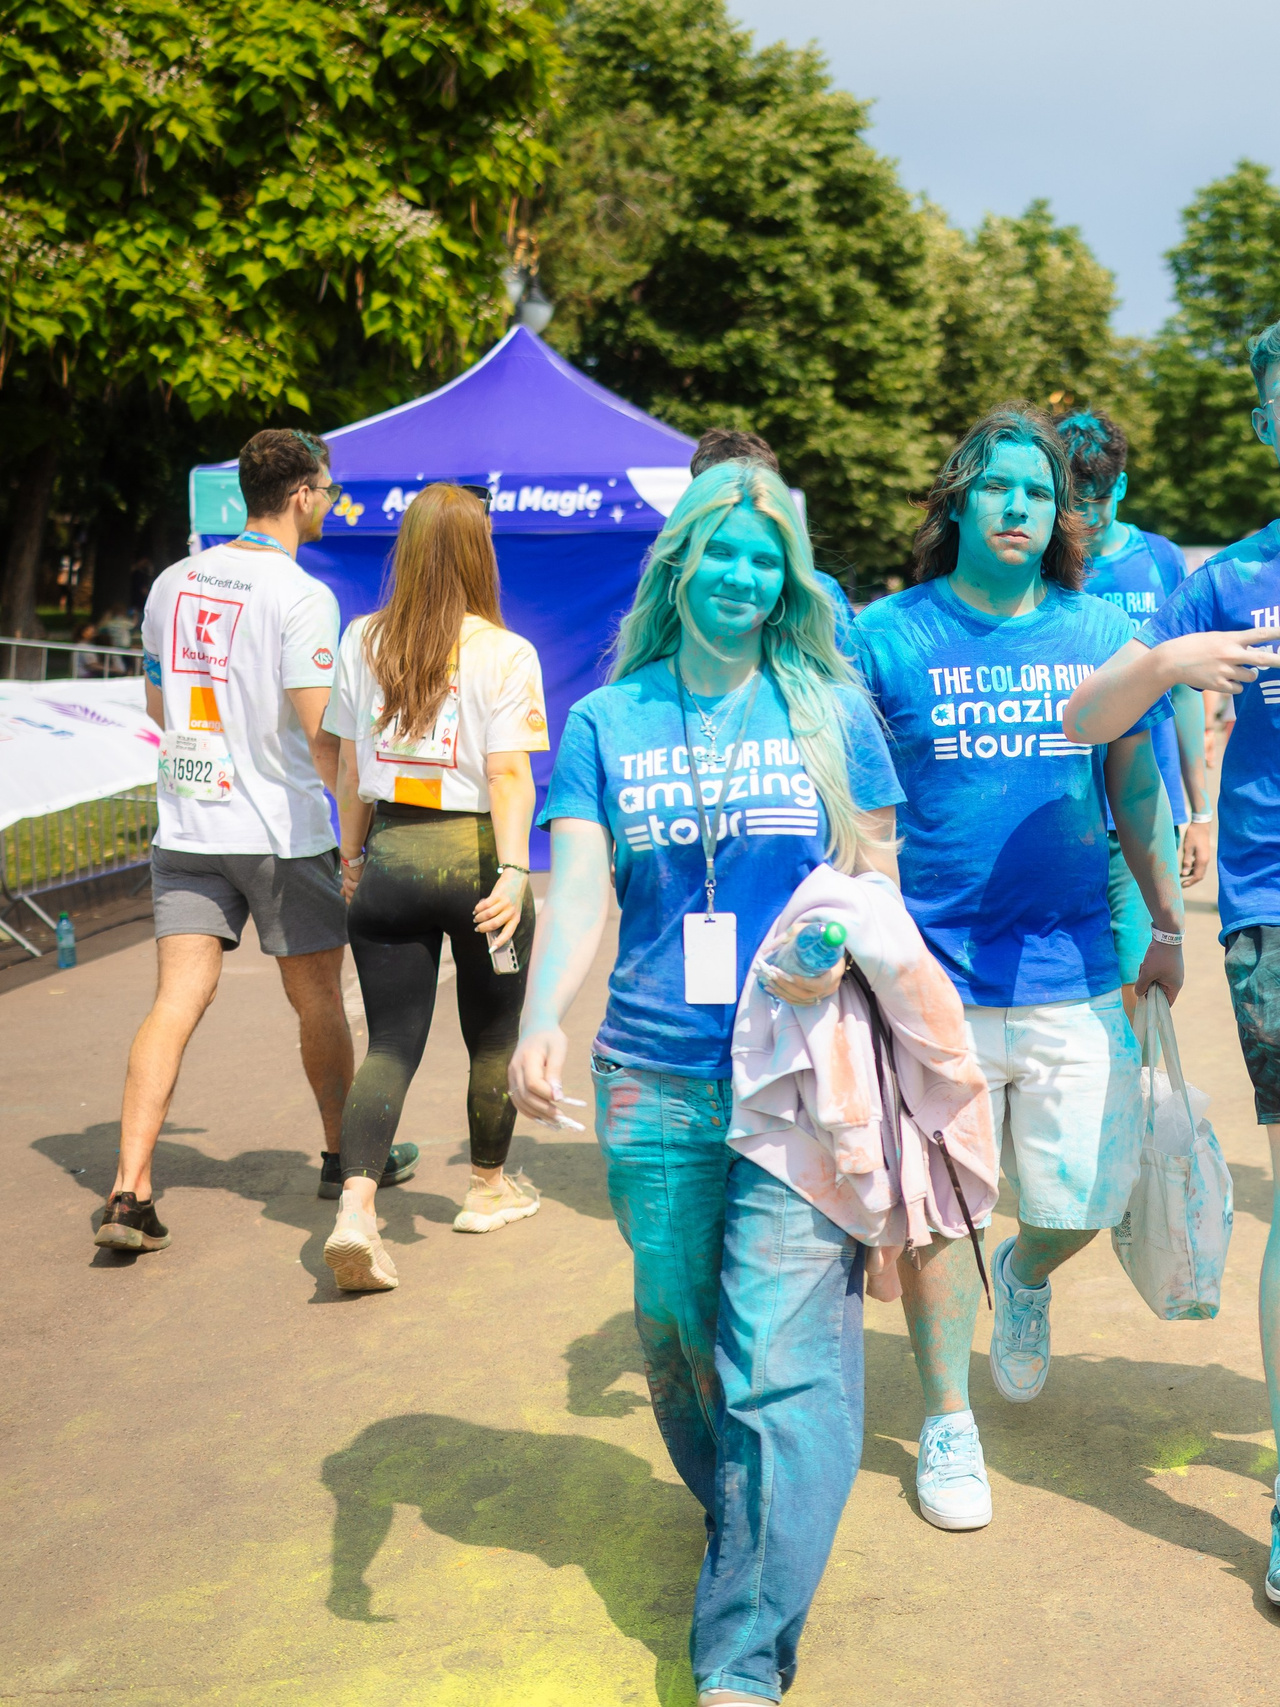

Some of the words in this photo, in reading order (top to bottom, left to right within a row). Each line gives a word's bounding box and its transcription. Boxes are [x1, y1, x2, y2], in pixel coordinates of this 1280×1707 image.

[518, 483, 603, 517] Magic
[196, 573, 232, 588] UniCredit
[233, 580, 253, 592] Bank
[928, 667, 974, 695] THE
[976, 664, 1050, 693] COLOR
[1054, 664, 1095, 691] RUN
[620, 748, 668, 780] THE
[764, 738, 804, 767] RU
[959, 730, 1036, 758] tour
[173, 757, 213, 783] 15922
[618, 768, 818, 814] amazing
